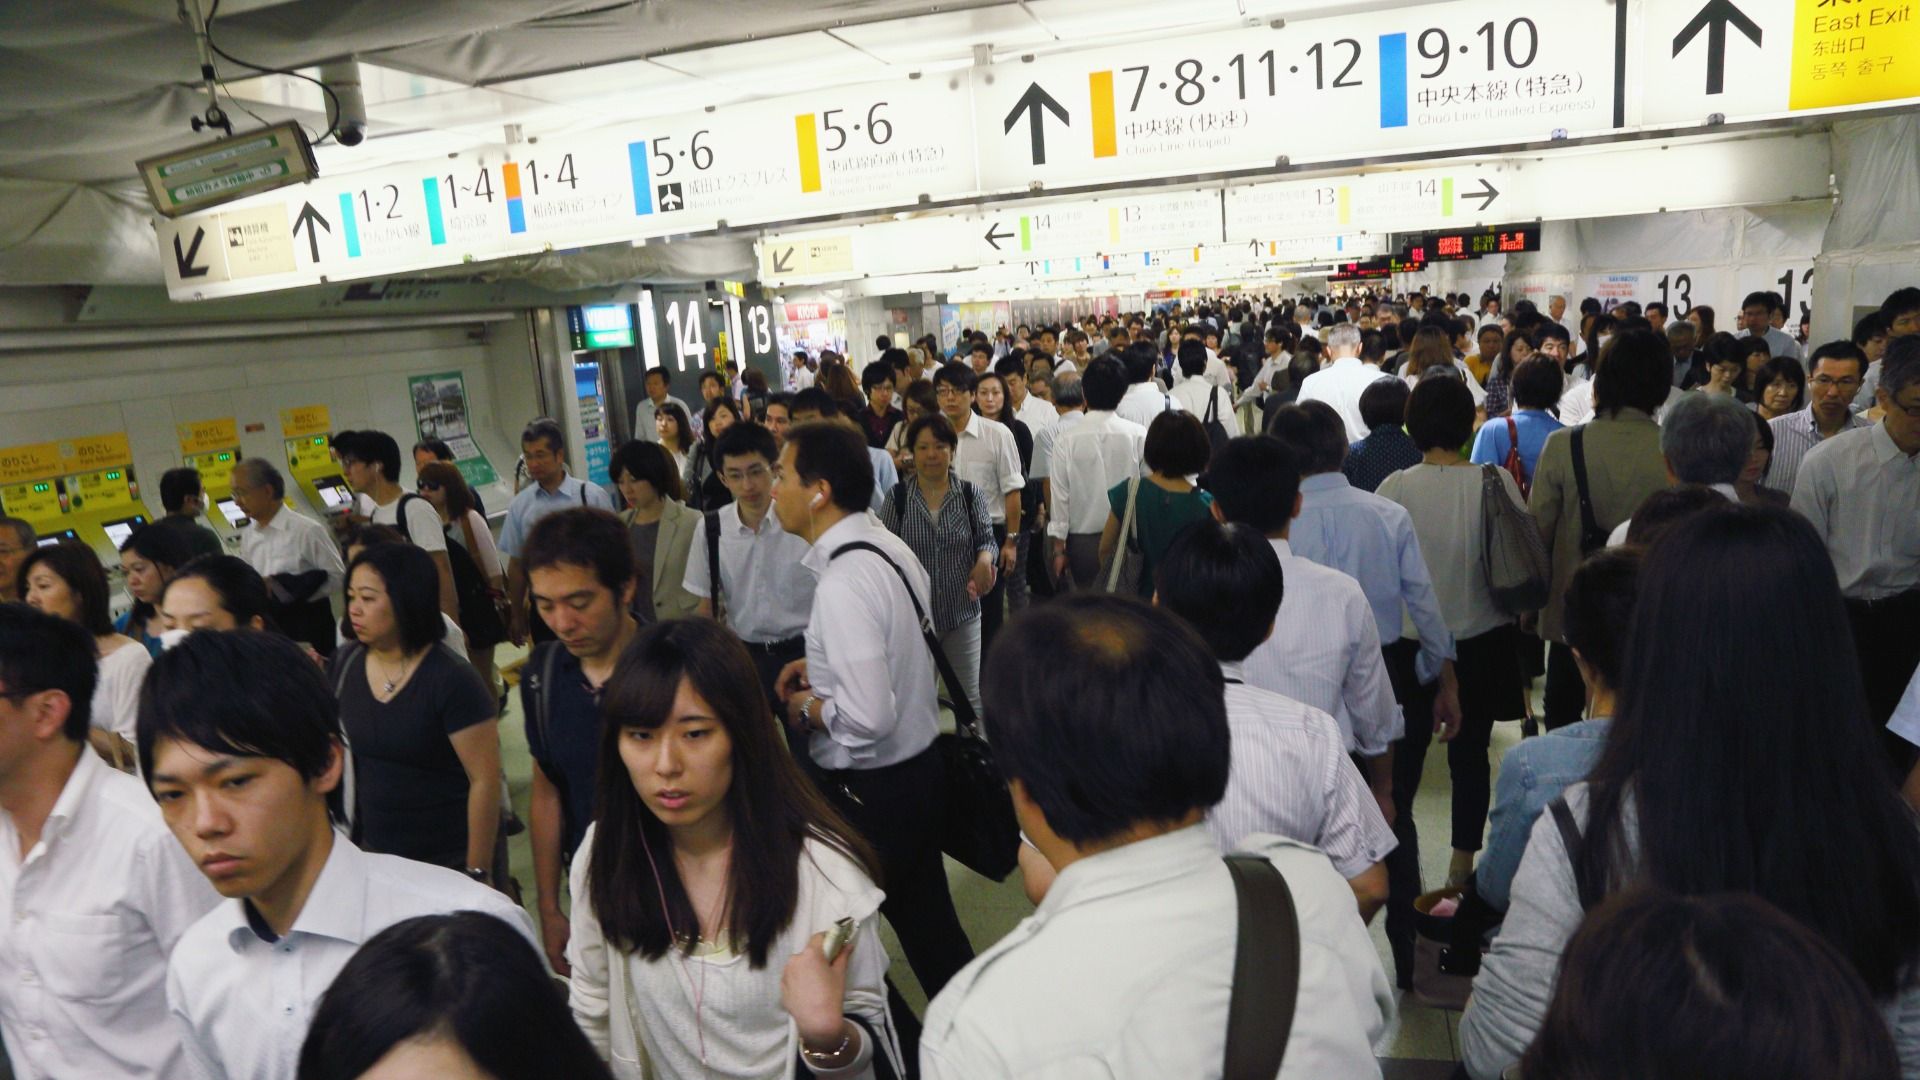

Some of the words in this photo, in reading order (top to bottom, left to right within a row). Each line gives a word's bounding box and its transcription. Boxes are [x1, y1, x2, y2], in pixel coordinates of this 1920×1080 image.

[1814, 12, 1861, 34] East
[1869, 5, 1911, 27] Exit
[1813, 36, 1865, 57] 东出口
[1811, 61, 1848, 81] 동쪽
[1856, 55, 1896, 76] 출구
[1454, 109, 1480, 122] Line
[1316, 187, 1335, 205] 13
[1416, 179, 1436, 197] 14
[1033, 214, 1050, 230] 14
[1124, 205, 1141, 222] 13
[1658, 273, 1692, 321] 13
[797, 304, 819, 320] KIOSK
[666, 300, 707, 372] 14
[748, 305, 772, 354] 13
